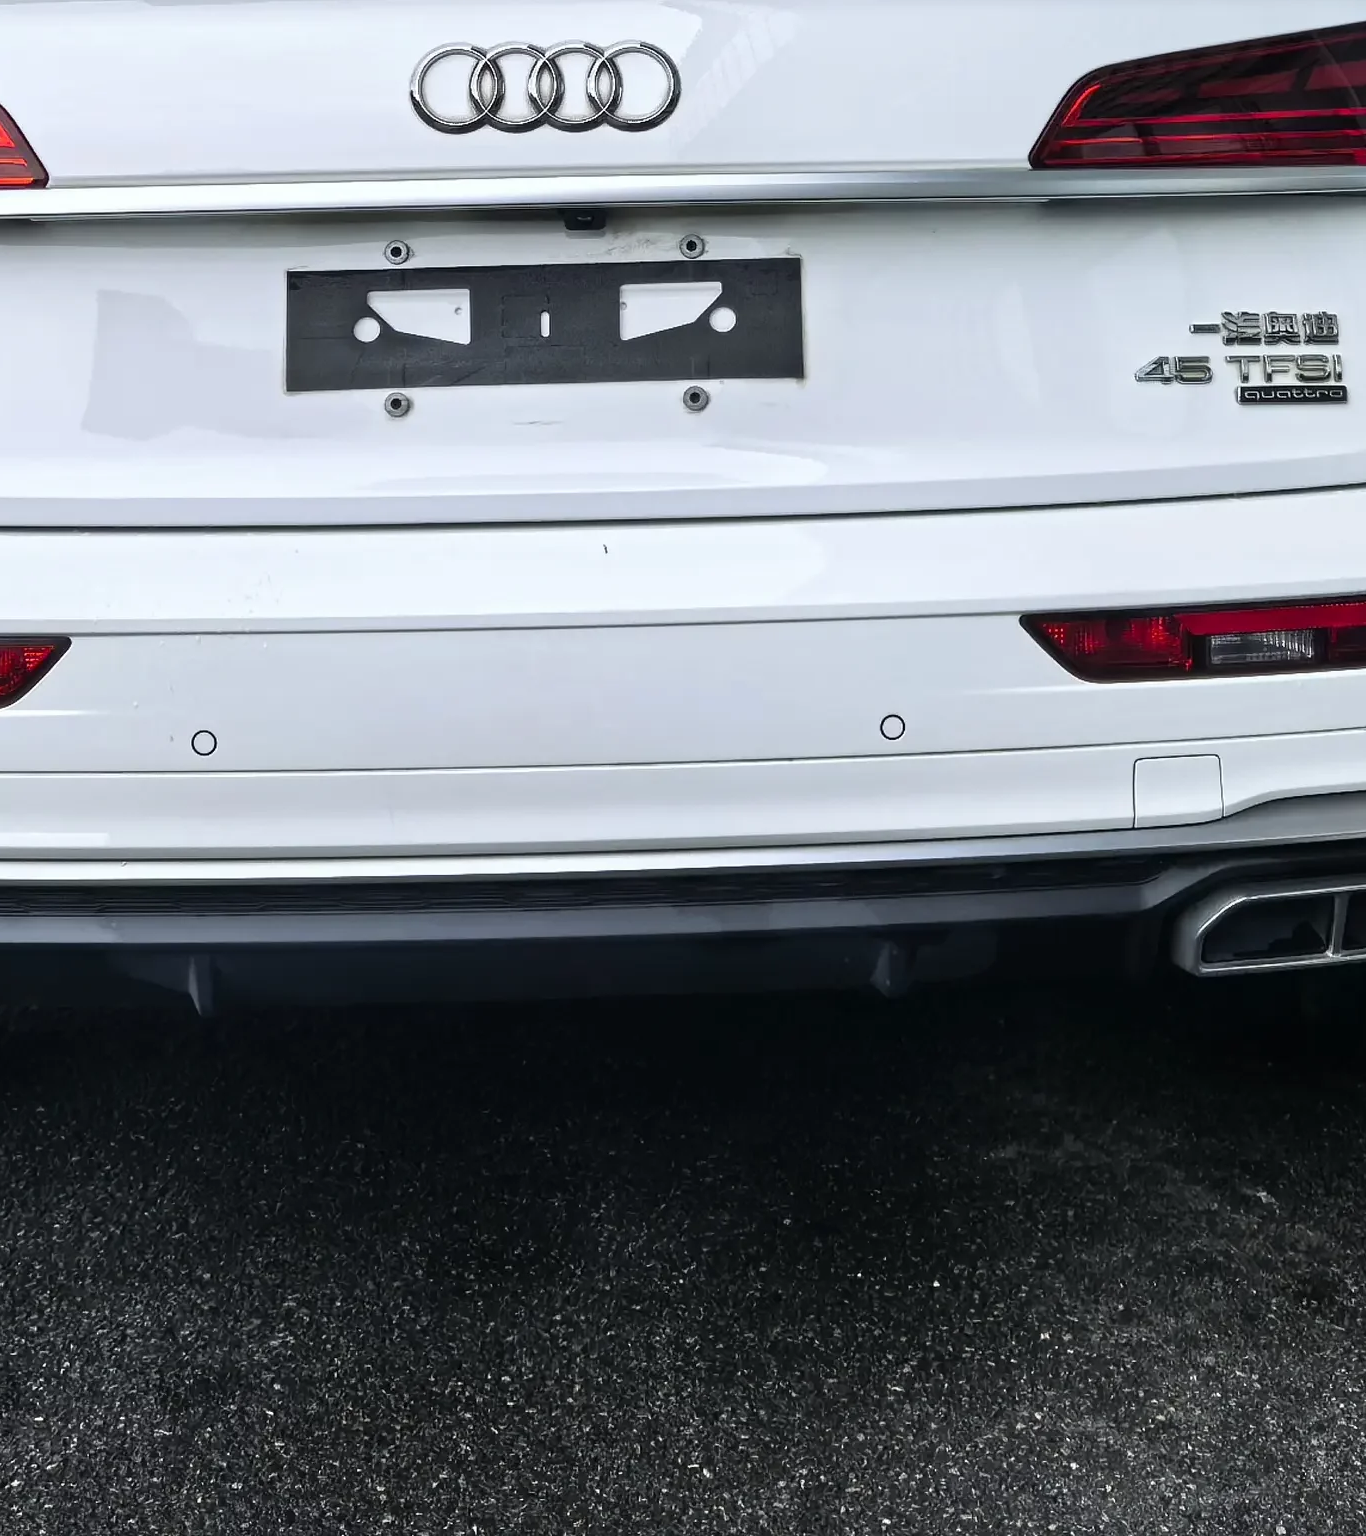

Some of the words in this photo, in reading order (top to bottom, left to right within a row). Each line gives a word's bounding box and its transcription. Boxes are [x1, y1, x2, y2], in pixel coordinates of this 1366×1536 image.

[1135, 356, 1213, 384] 45
[1225, 354, 1343, 383] TFSI
[1243, 388, 1344, 402] quattro
